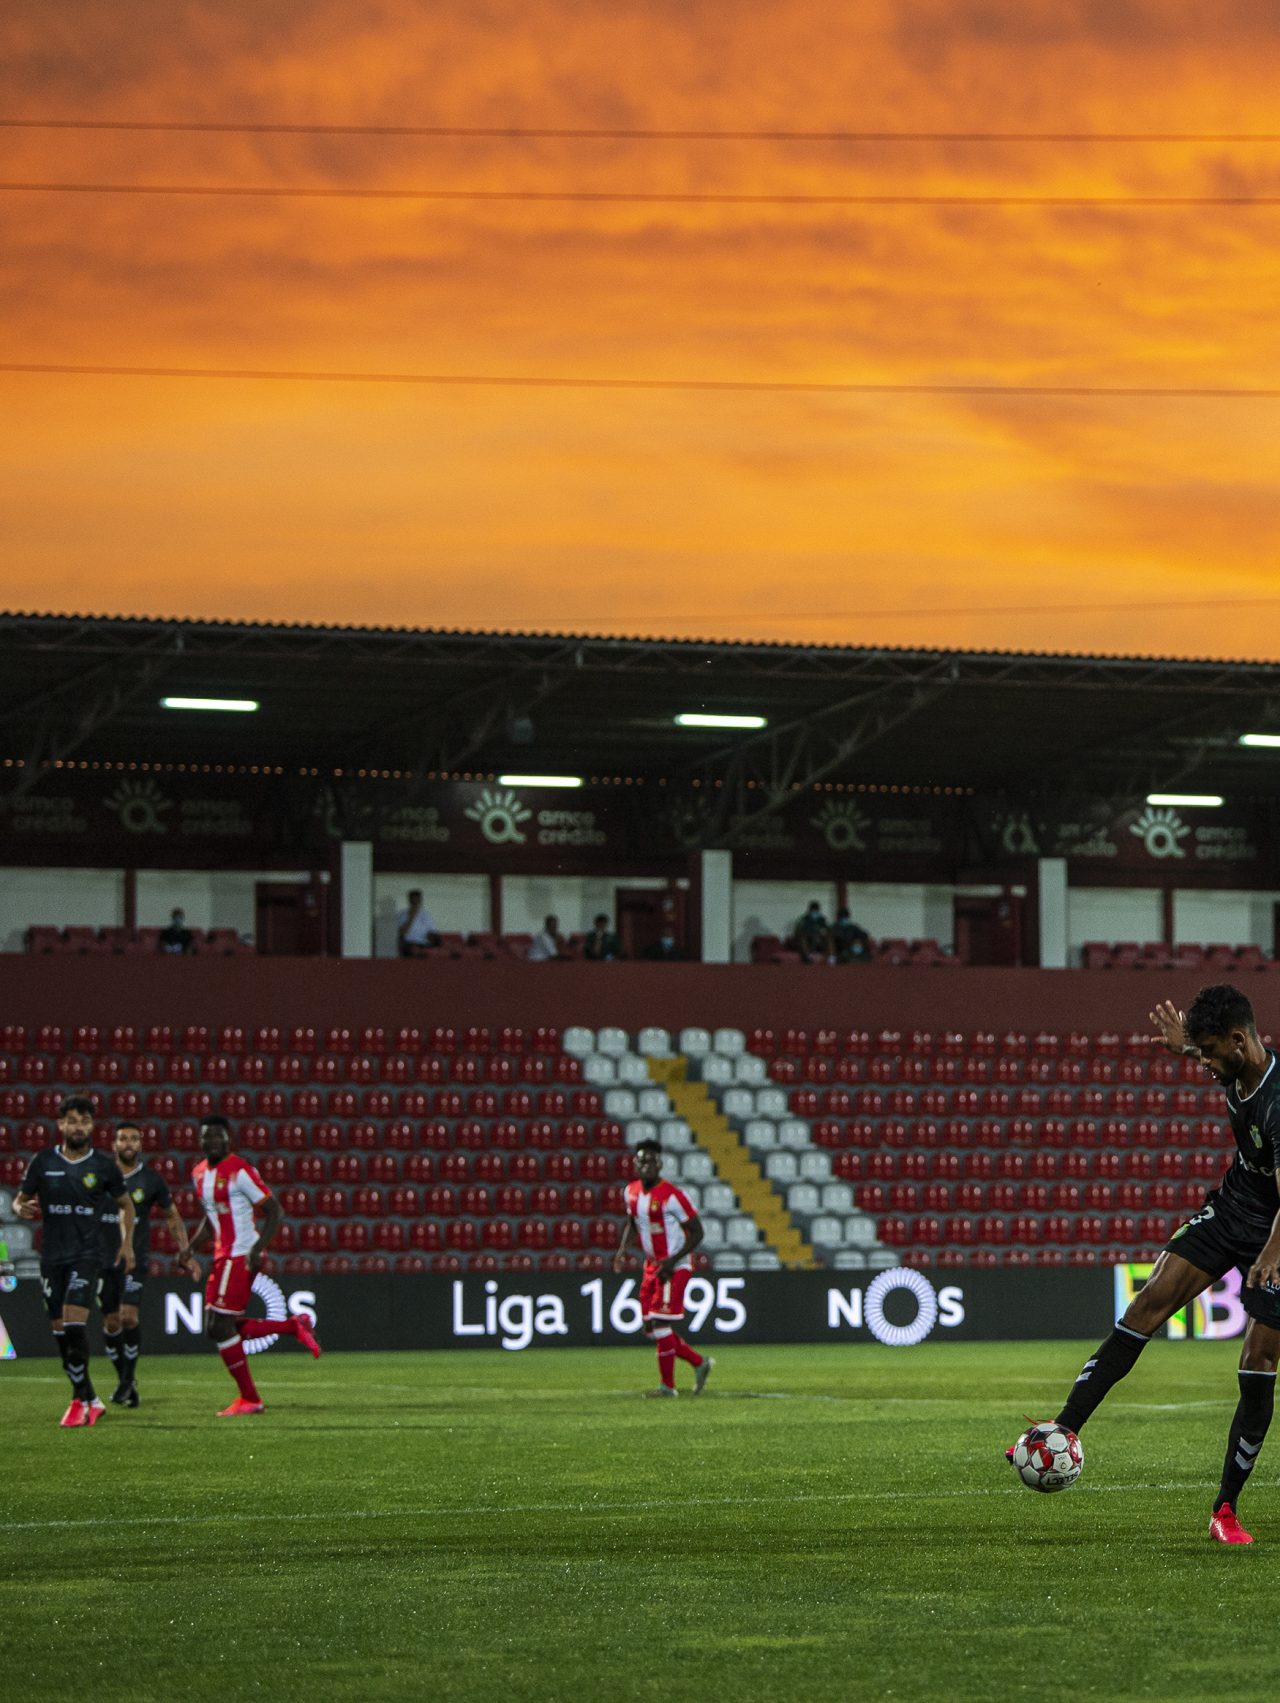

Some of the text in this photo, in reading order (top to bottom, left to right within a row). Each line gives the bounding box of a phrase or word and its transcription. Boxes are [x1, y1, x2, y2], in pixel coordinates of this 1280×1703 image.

[453, 1277, 747, 1351] Liga 1695
[828, 1267, 964, 1346] NOS
